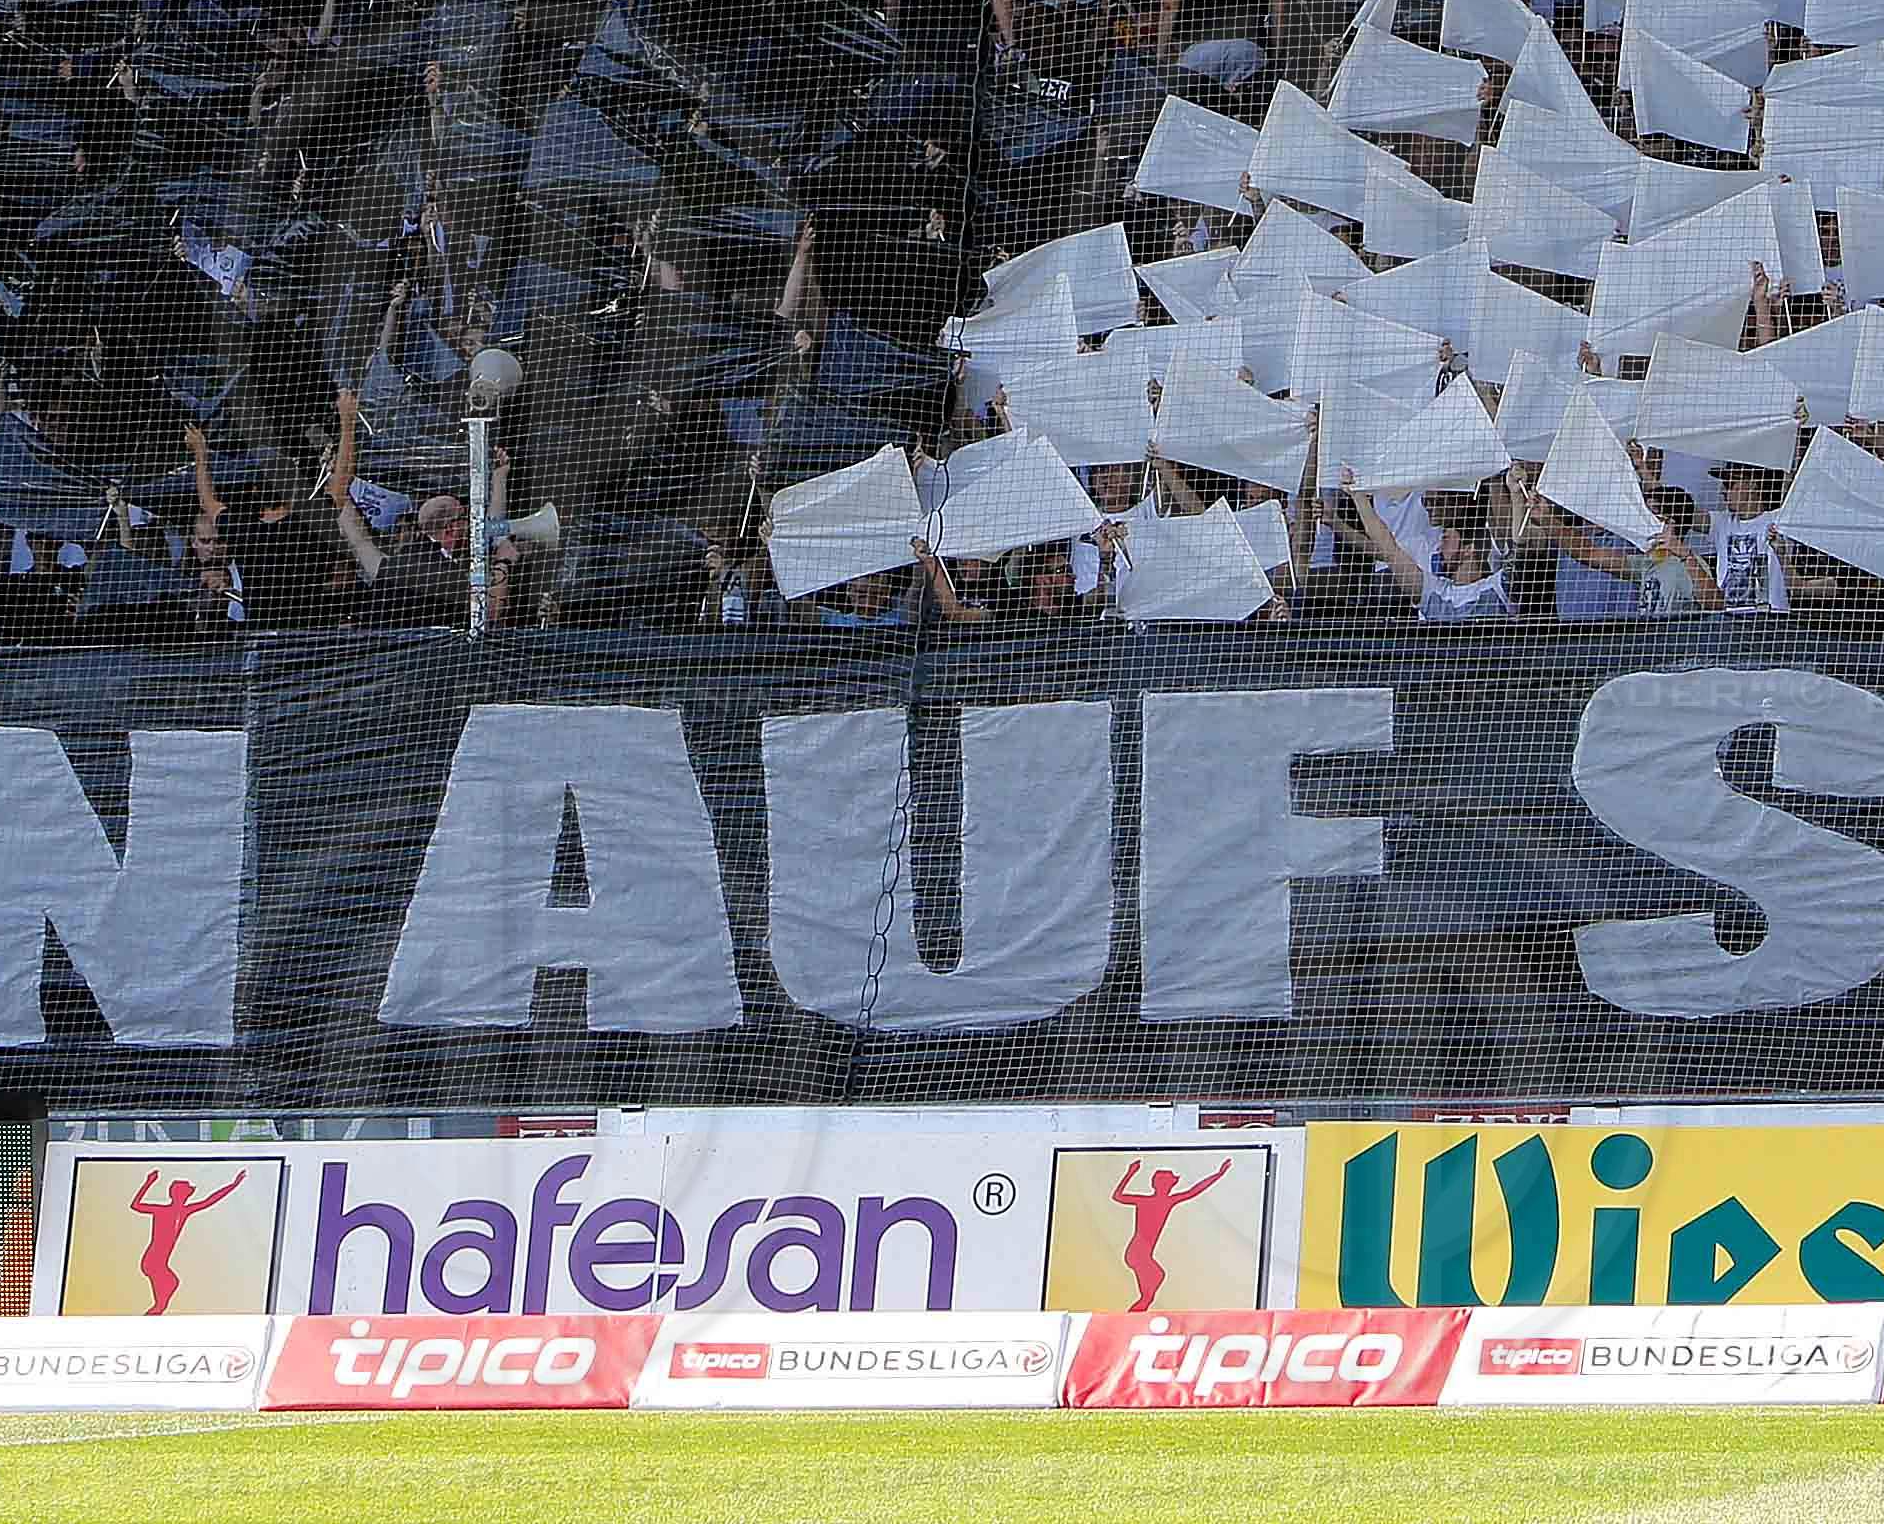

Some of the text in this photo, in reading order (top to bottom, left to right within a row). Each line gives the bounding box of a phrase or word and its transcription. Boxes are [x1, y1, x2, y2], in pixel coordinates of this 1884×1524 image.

[377, 686, 1395, 1034] AUF
[315, 1154, 957, 1314] hafesan
[332, 1319, 596, 1398] tipico
[678, 1346, 1009, 1375] tipico BUNDESLIGA
[1128, 1315, 1404, 1396] tipico
[1486, 1340, 1829, 1373] tipico BUNDESLIGA
